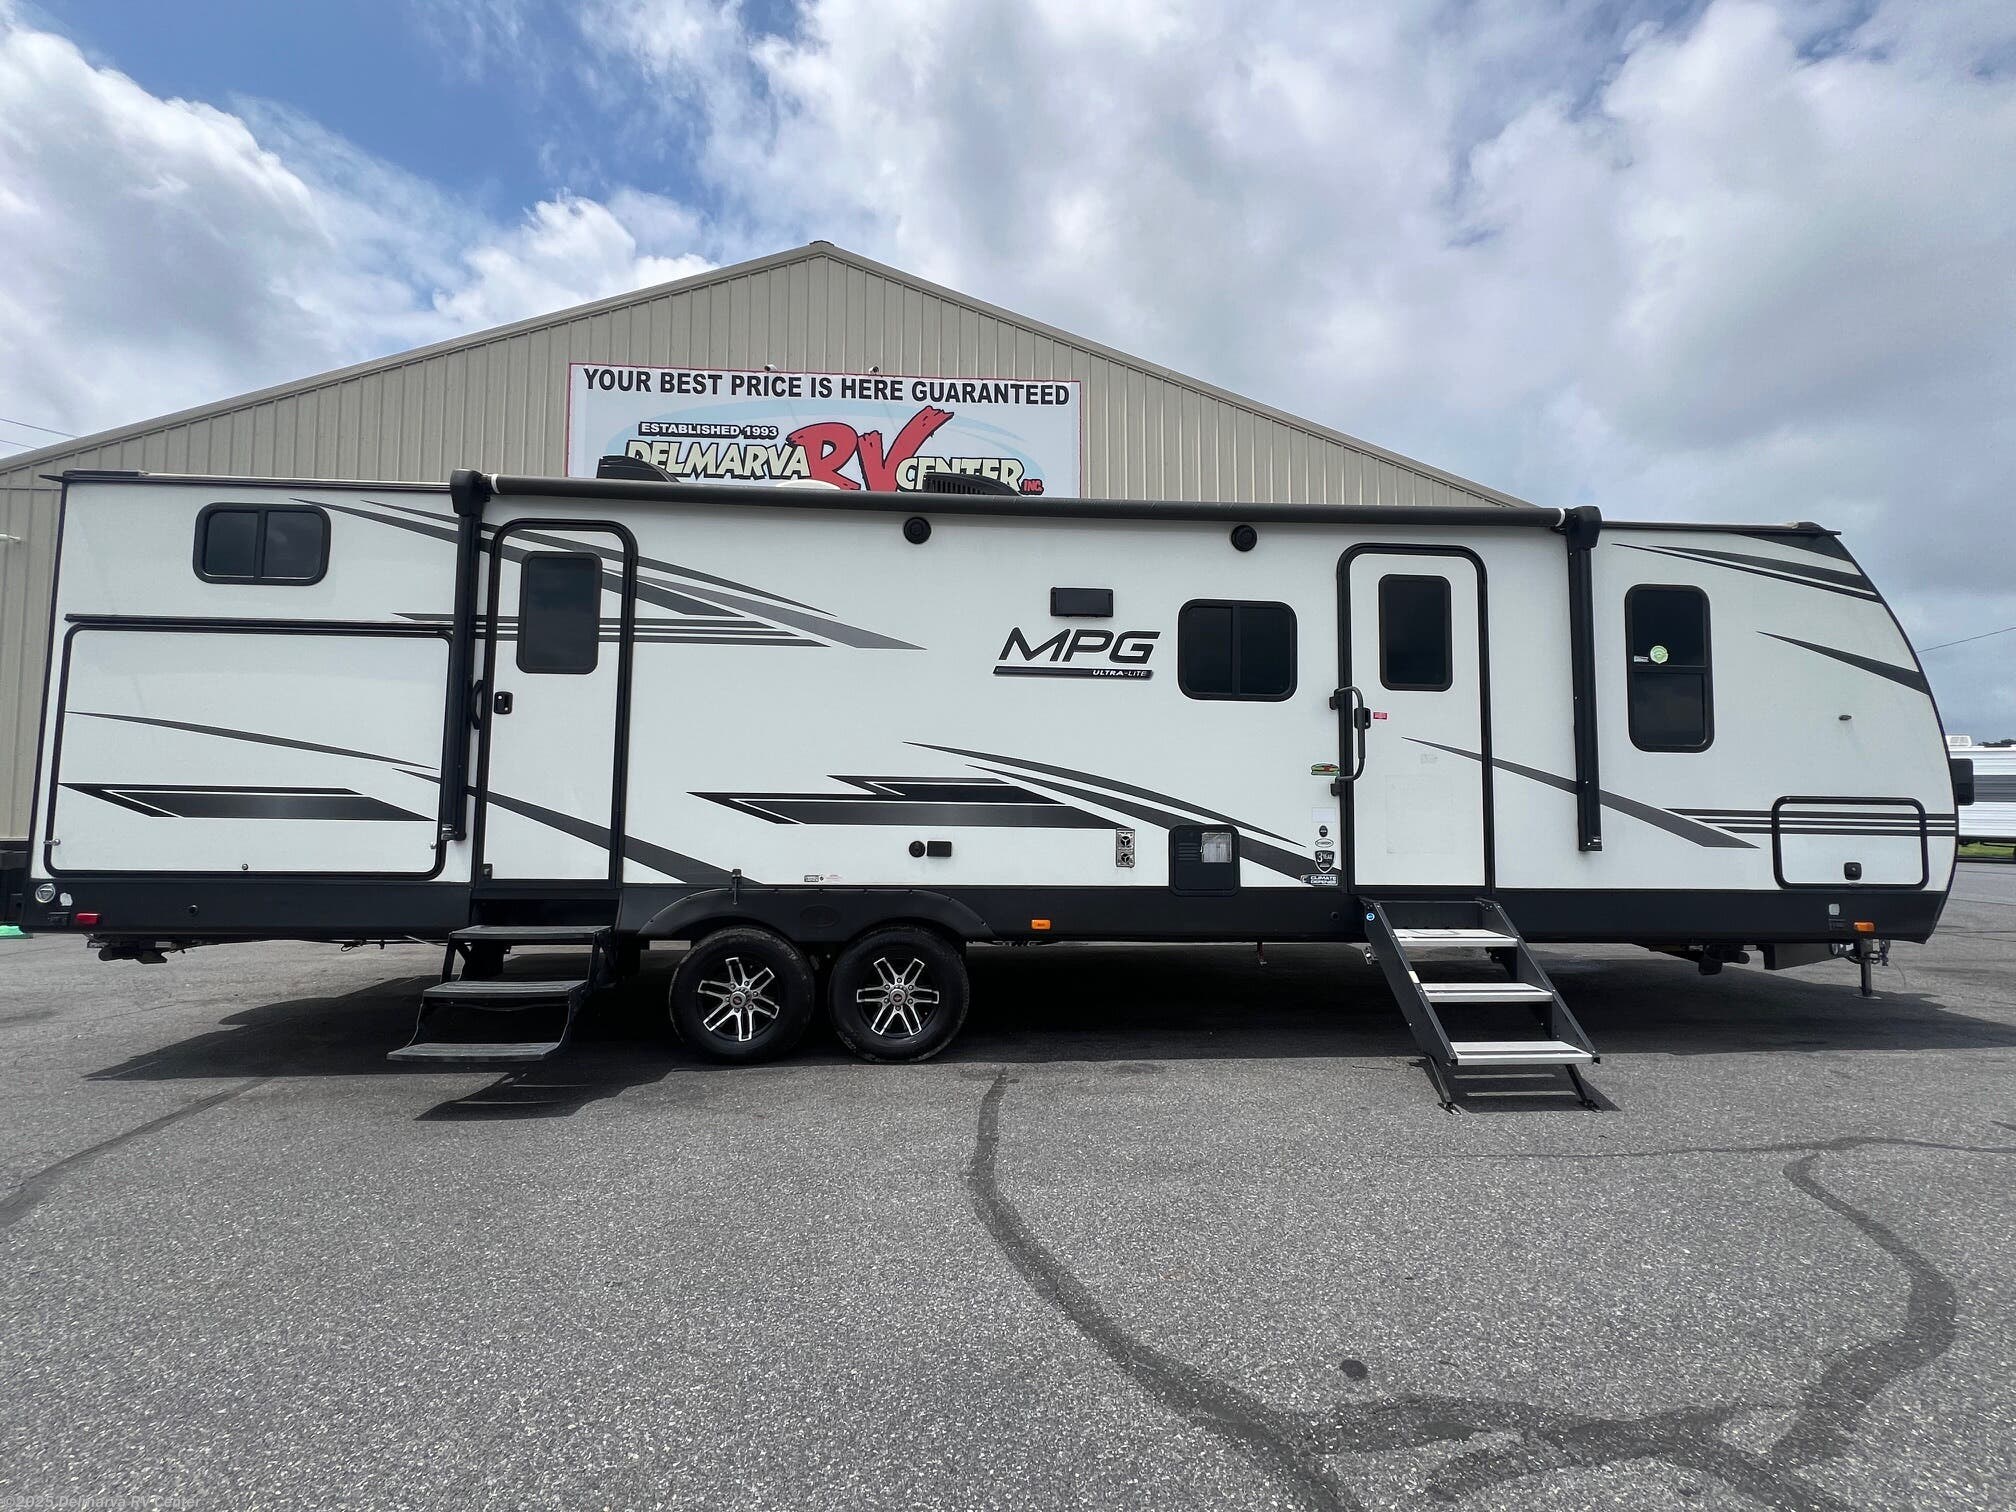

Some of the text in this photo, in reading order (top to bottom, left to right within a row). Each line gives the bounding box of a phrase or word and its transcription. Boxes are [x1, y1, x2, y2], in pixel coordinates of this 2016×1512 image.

[583, 368, 1070, 406] YOUR BEST PRICE IS HERE GUARANTEED
[640, 423, 778, 437] ESTABLISHED 1993
[626, 440, 812, 480] DELMARVA
[786, 405, 955, 492] RV
[1021, 479, 1044, 495] INC.
[998, 626, 1161, 665] MPG
[1092, 669, 1148, 677] ULTRA-LITE
